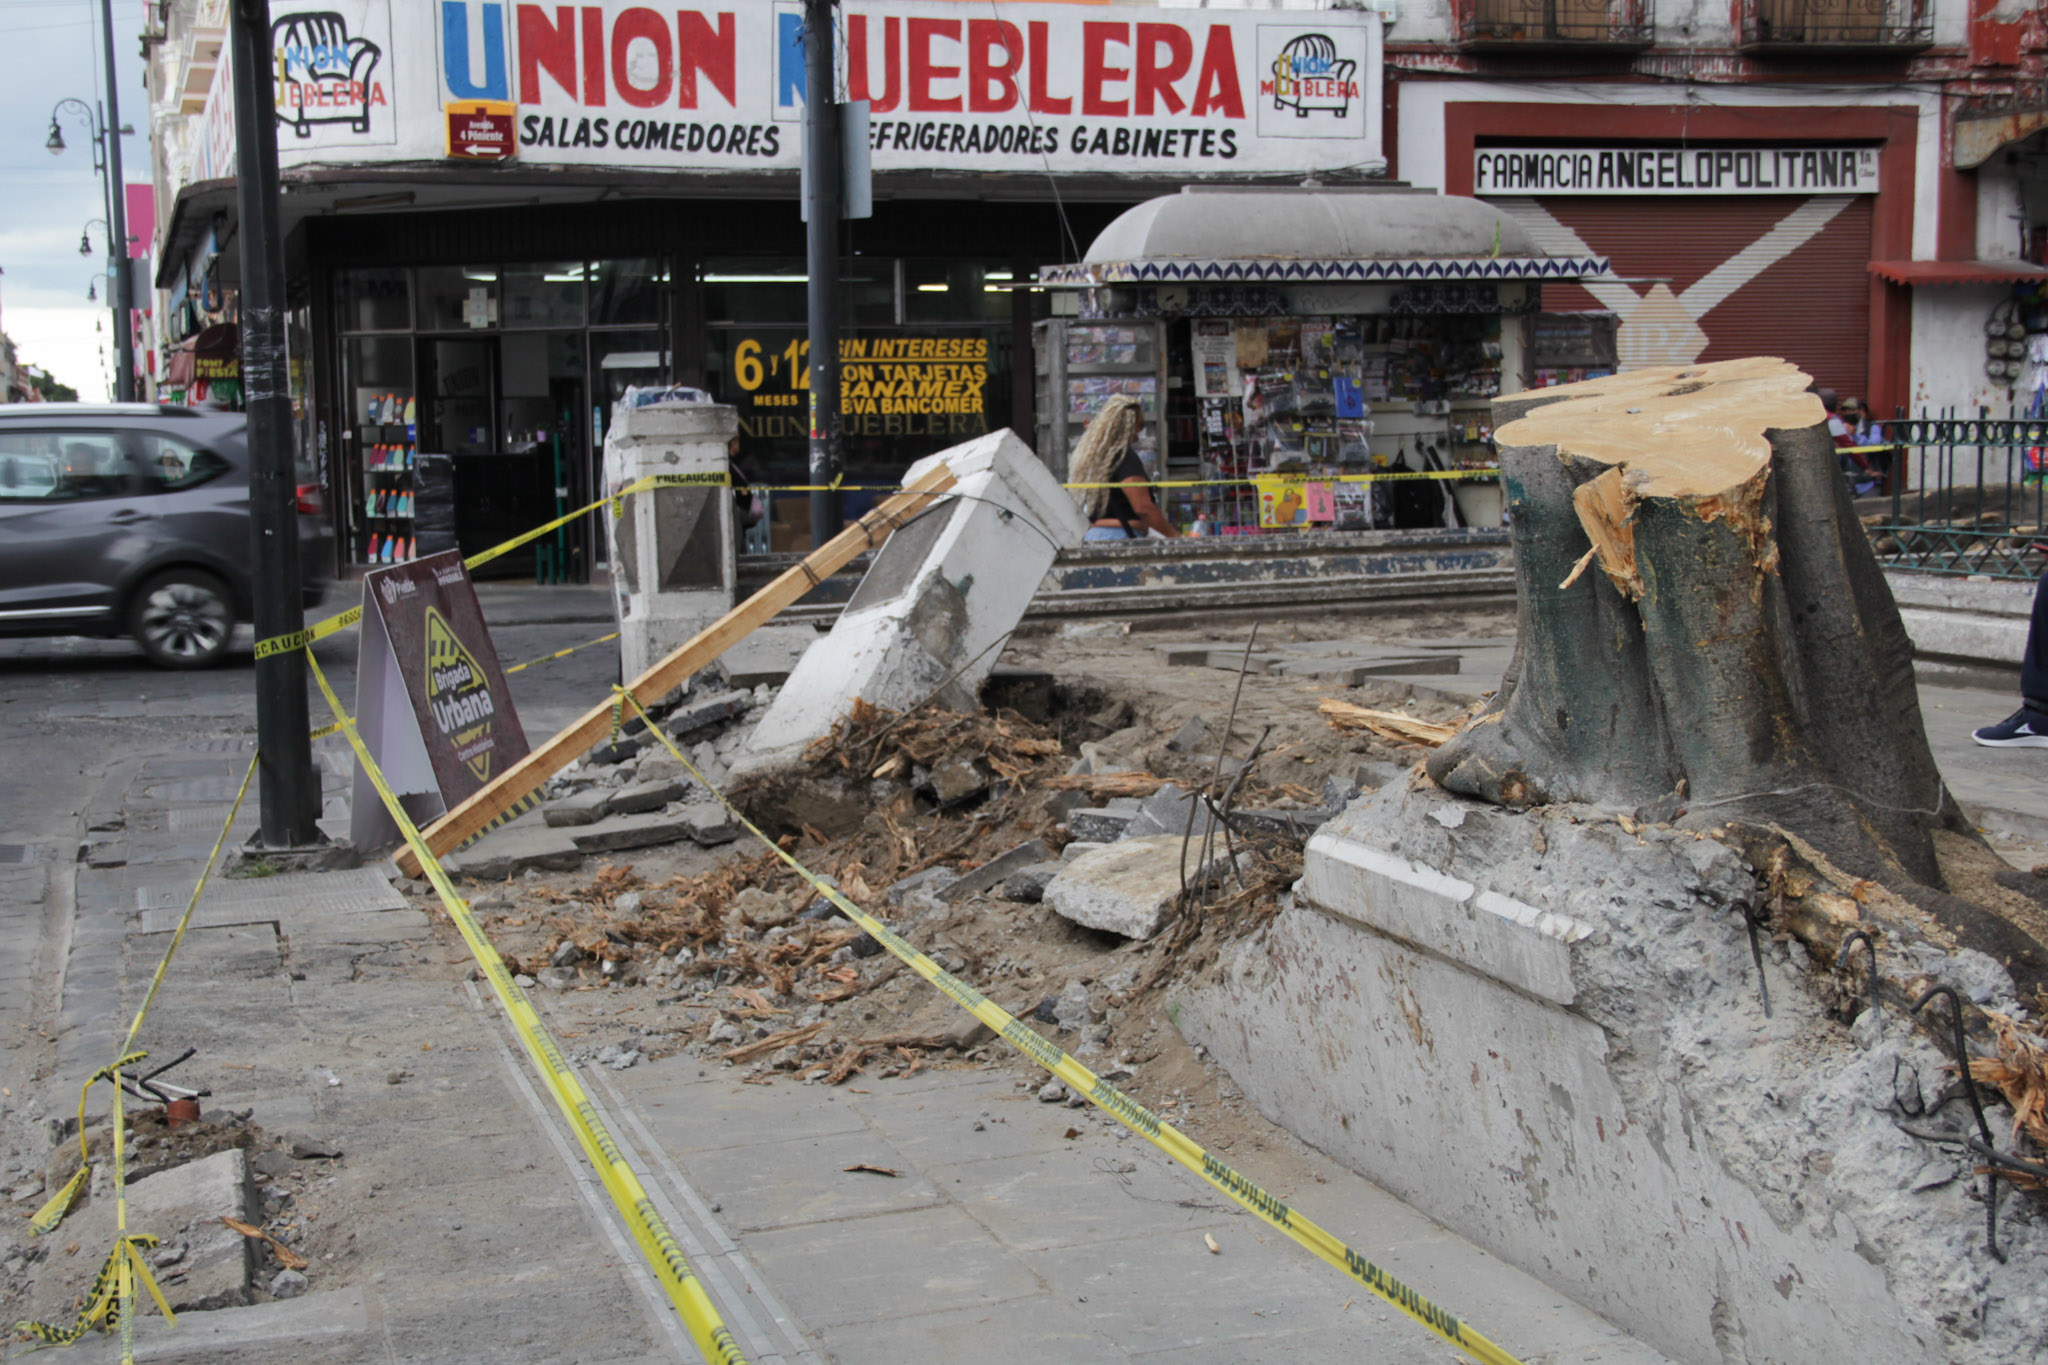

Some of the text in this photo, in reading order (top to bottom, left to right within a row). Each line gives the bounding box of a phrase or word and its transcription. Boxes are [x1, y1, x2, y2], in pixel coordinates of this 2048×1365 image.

[442, 1, 736, 109] UNION
[1260, 79, 1359, 98] MUEBLERA
[520, 115, 1238, 159] SALAS COMEDORES EFRIGERADORES GABINETES
[1477, 149, 1859, 189] FARMACIA ANGELOPOLITANA
[872, 338, 988, 358] INTERESES
[734, 338, 764, 391] 6
[784, 338, 811, 391] 12
[840, 364, 988, 382] ON TARJETAS
[753, 395, 799, 407] MESES
[840, 380, 986, 399] BANAMEX
[880, 398, 985, 414] BANCOMER
[737, 413, 990, 438] NION UEBLERA
[434, 662, 471, 691] Brigada
[432, 689, 494, 734] Urbana
